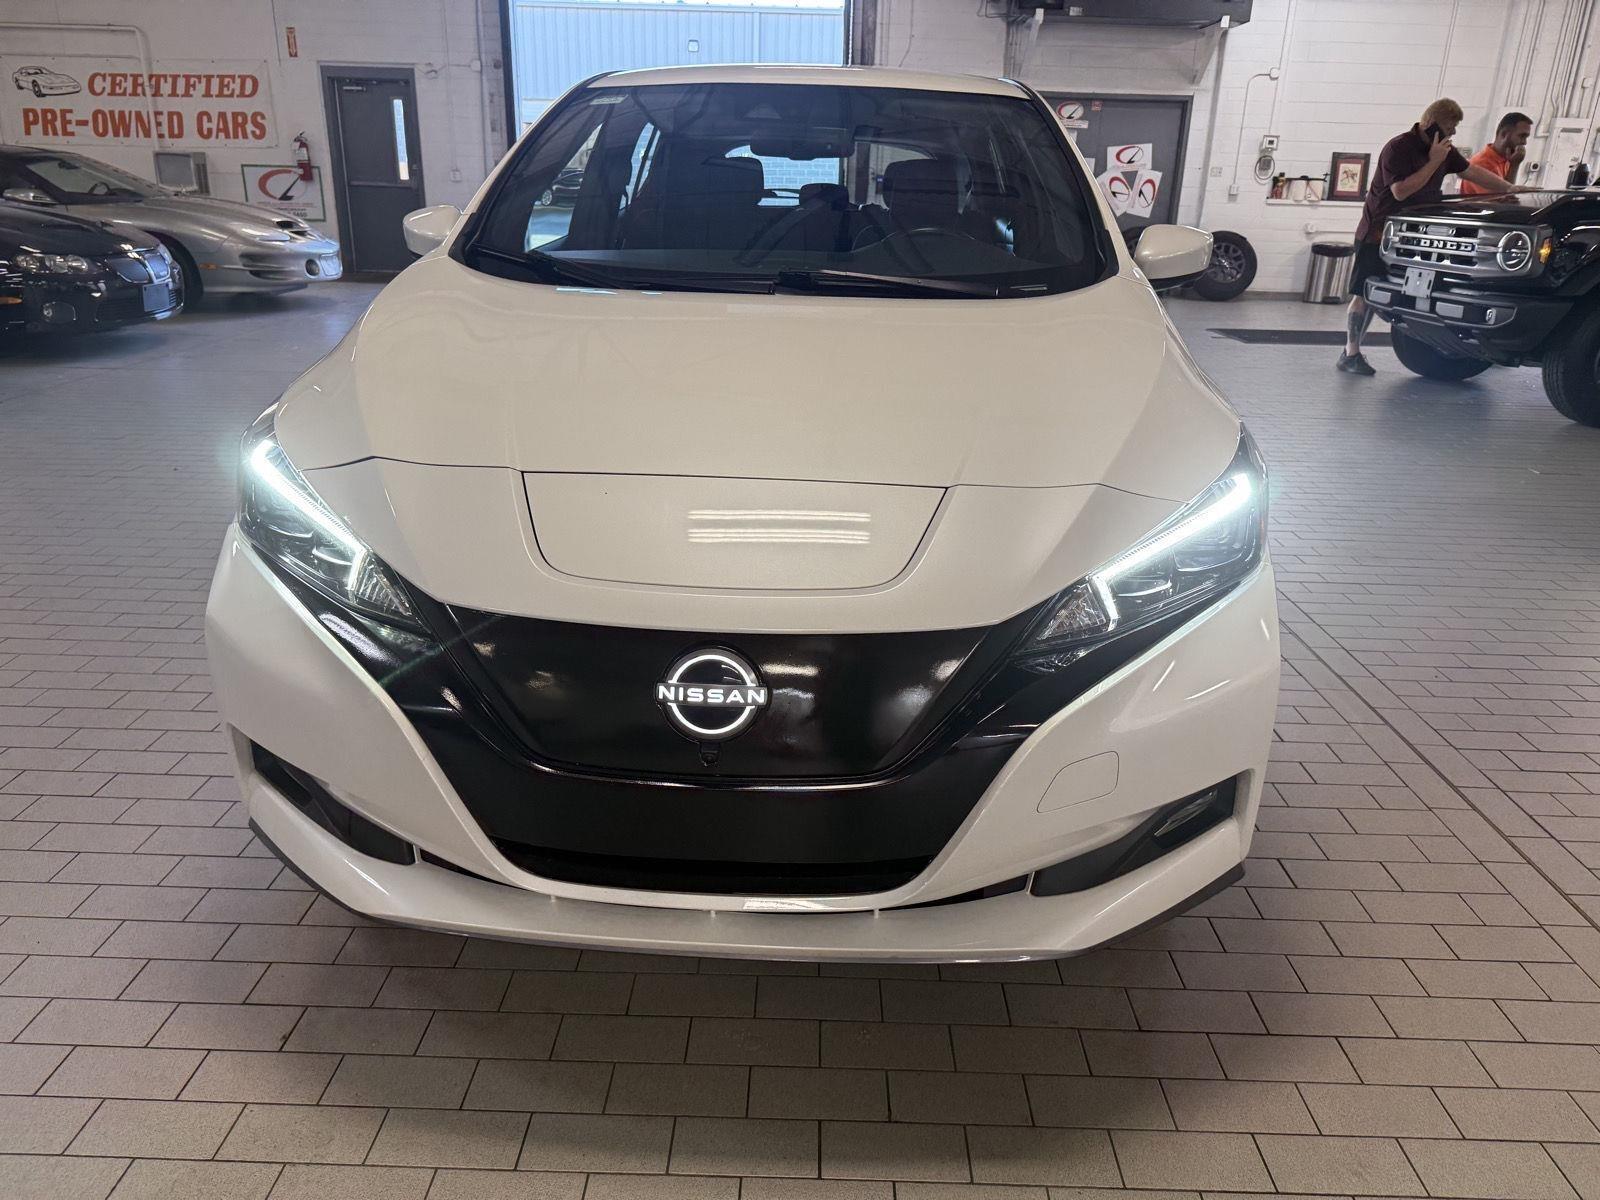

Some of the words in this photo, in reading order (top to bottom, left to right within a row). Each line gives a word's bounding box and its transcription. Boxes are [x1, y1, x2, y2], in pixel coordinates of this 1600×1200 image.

[87, 72, 259, 98] CERTIFIED
[22, 107, 184, 139] PRE-OWNED
[196, 110, 267, 140] CARS
[658, 685, 765, 704] NISSAN
